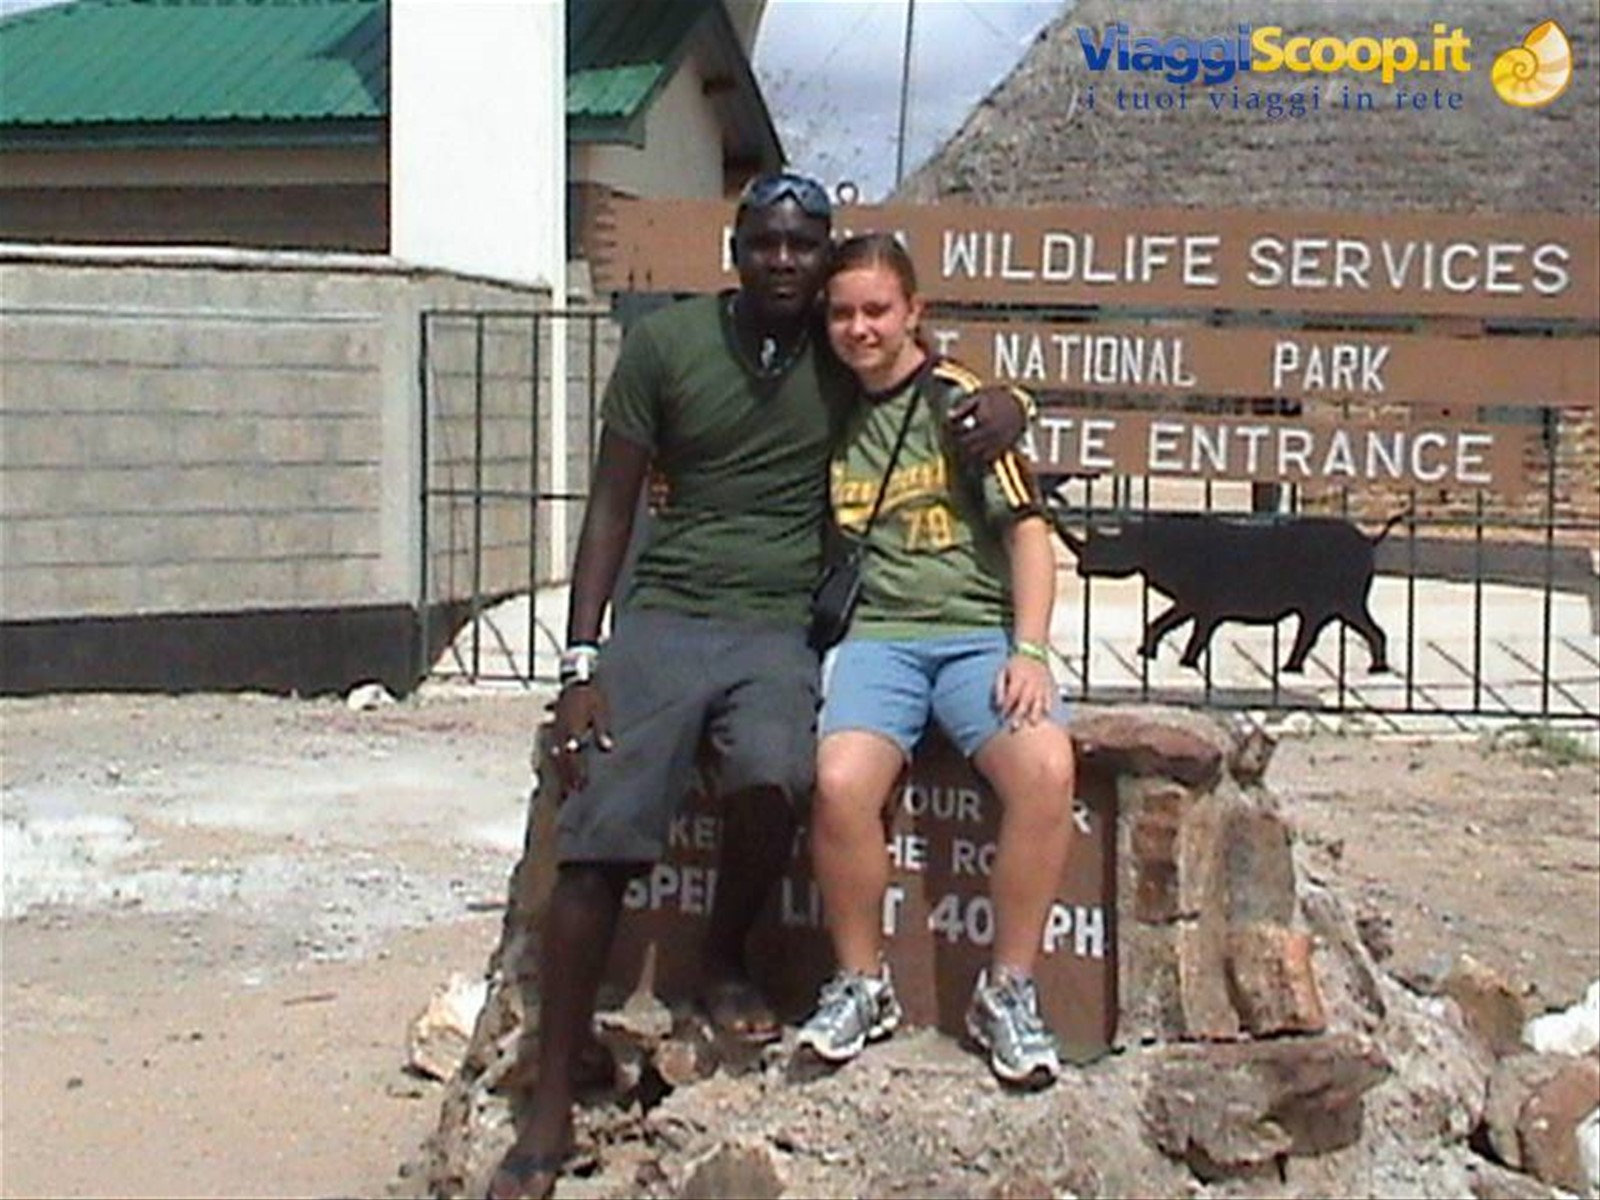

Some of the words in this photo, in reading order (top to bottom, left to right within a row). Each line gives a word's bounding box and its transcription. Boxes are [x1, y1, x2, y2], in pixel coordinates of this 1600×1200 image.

[942, 230, 1221, 287] WILDLIFE
[1247, 237, 1571, 295] SERVICES
[994, 332, 1197, 388] NATIONAL
[1272, 341, 1393, 393] PARK
[1020, 417, 1117, 469] ATE
[1147, 422, 1494, 484] ENTRANCE
[903, 786, 982, 823] OUR
[928, 893, 996, 946] 40
[1043, 903, 1105, 958] PH
